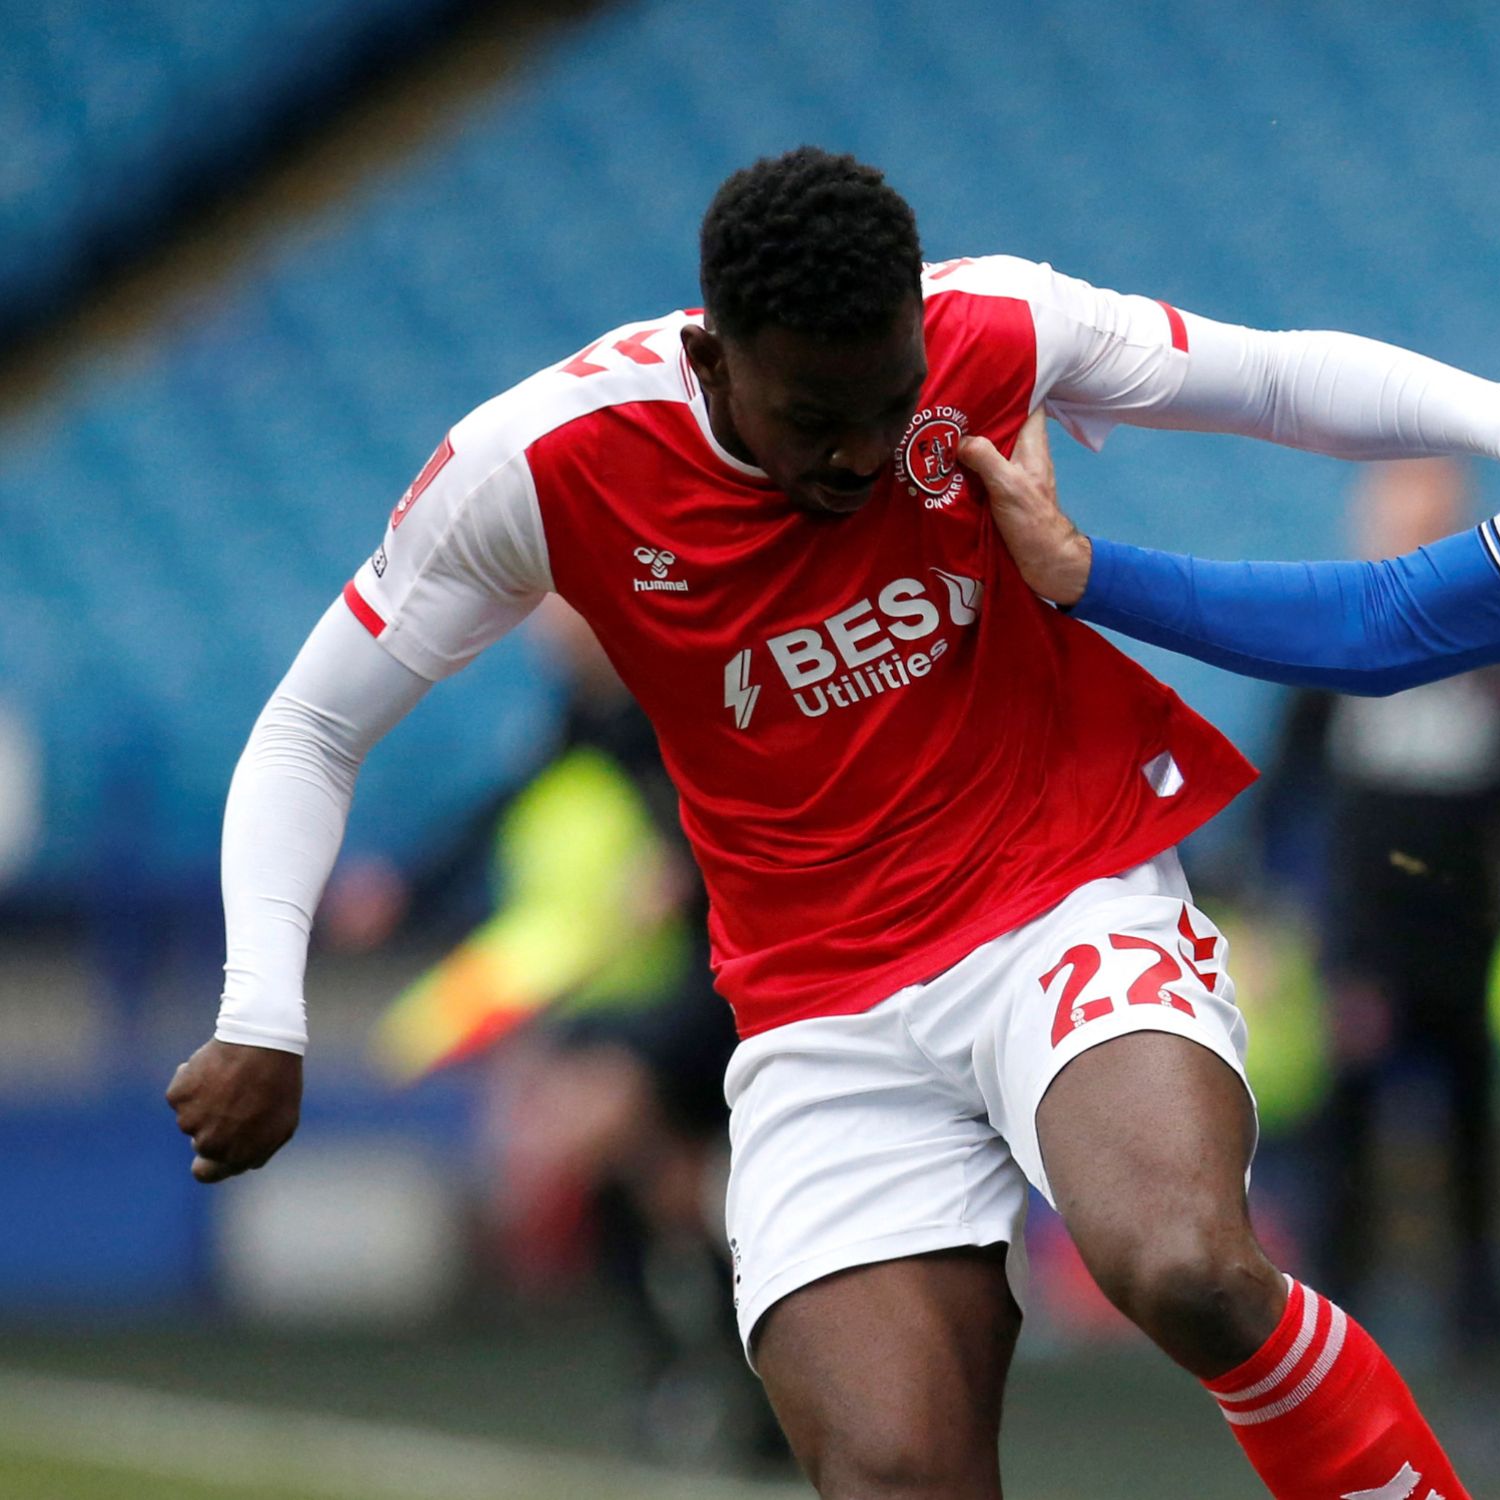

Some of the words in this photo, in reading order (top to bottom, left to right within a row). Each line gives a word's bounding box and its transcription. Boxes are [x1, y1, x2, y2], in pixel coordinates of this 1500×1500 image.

[924, 455, 935, 474] F
[924, 473, 964, 509] ONWARD
[634, 578, 689, 592] hummel
[766, 577, 940, 690] BES
[793, 638, 949, 718] Utilities
[1038, 932, 1196, 1050] 22
